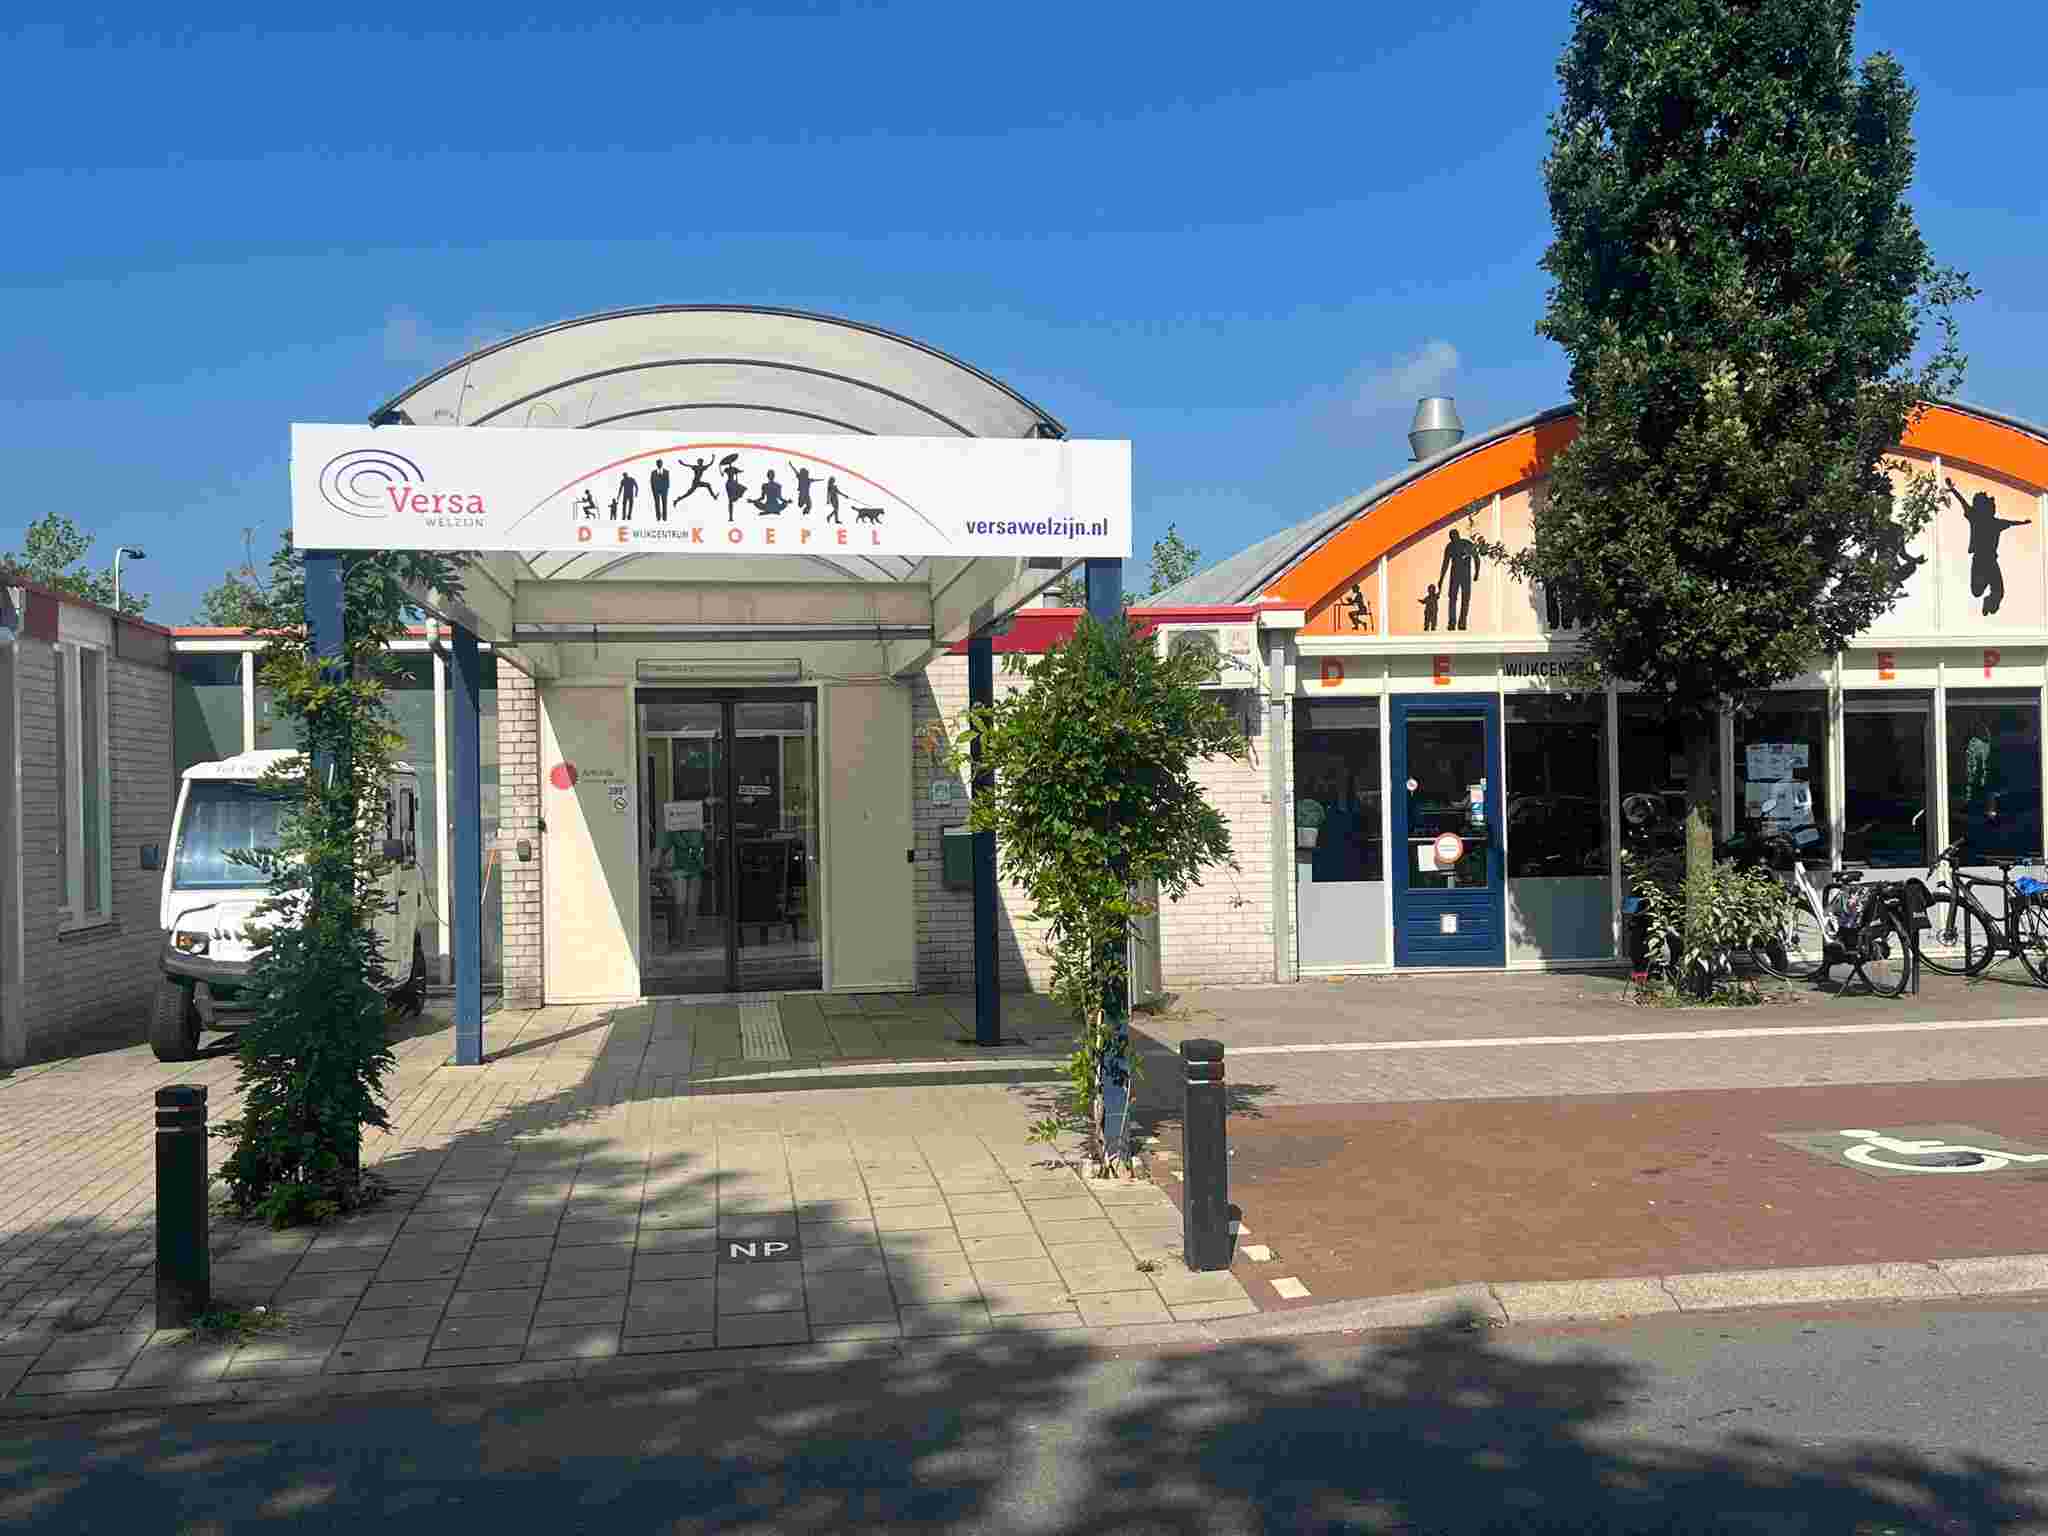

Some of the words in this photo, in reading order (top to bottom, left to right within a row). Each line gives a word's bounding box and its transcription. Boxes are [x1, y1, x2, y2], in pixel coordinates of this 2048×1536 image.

[386, 487, 485, 513] Versa
[966, 517, 1108, 539] versawelzijn.nl
[730, 1242, 789, 1258] NP
